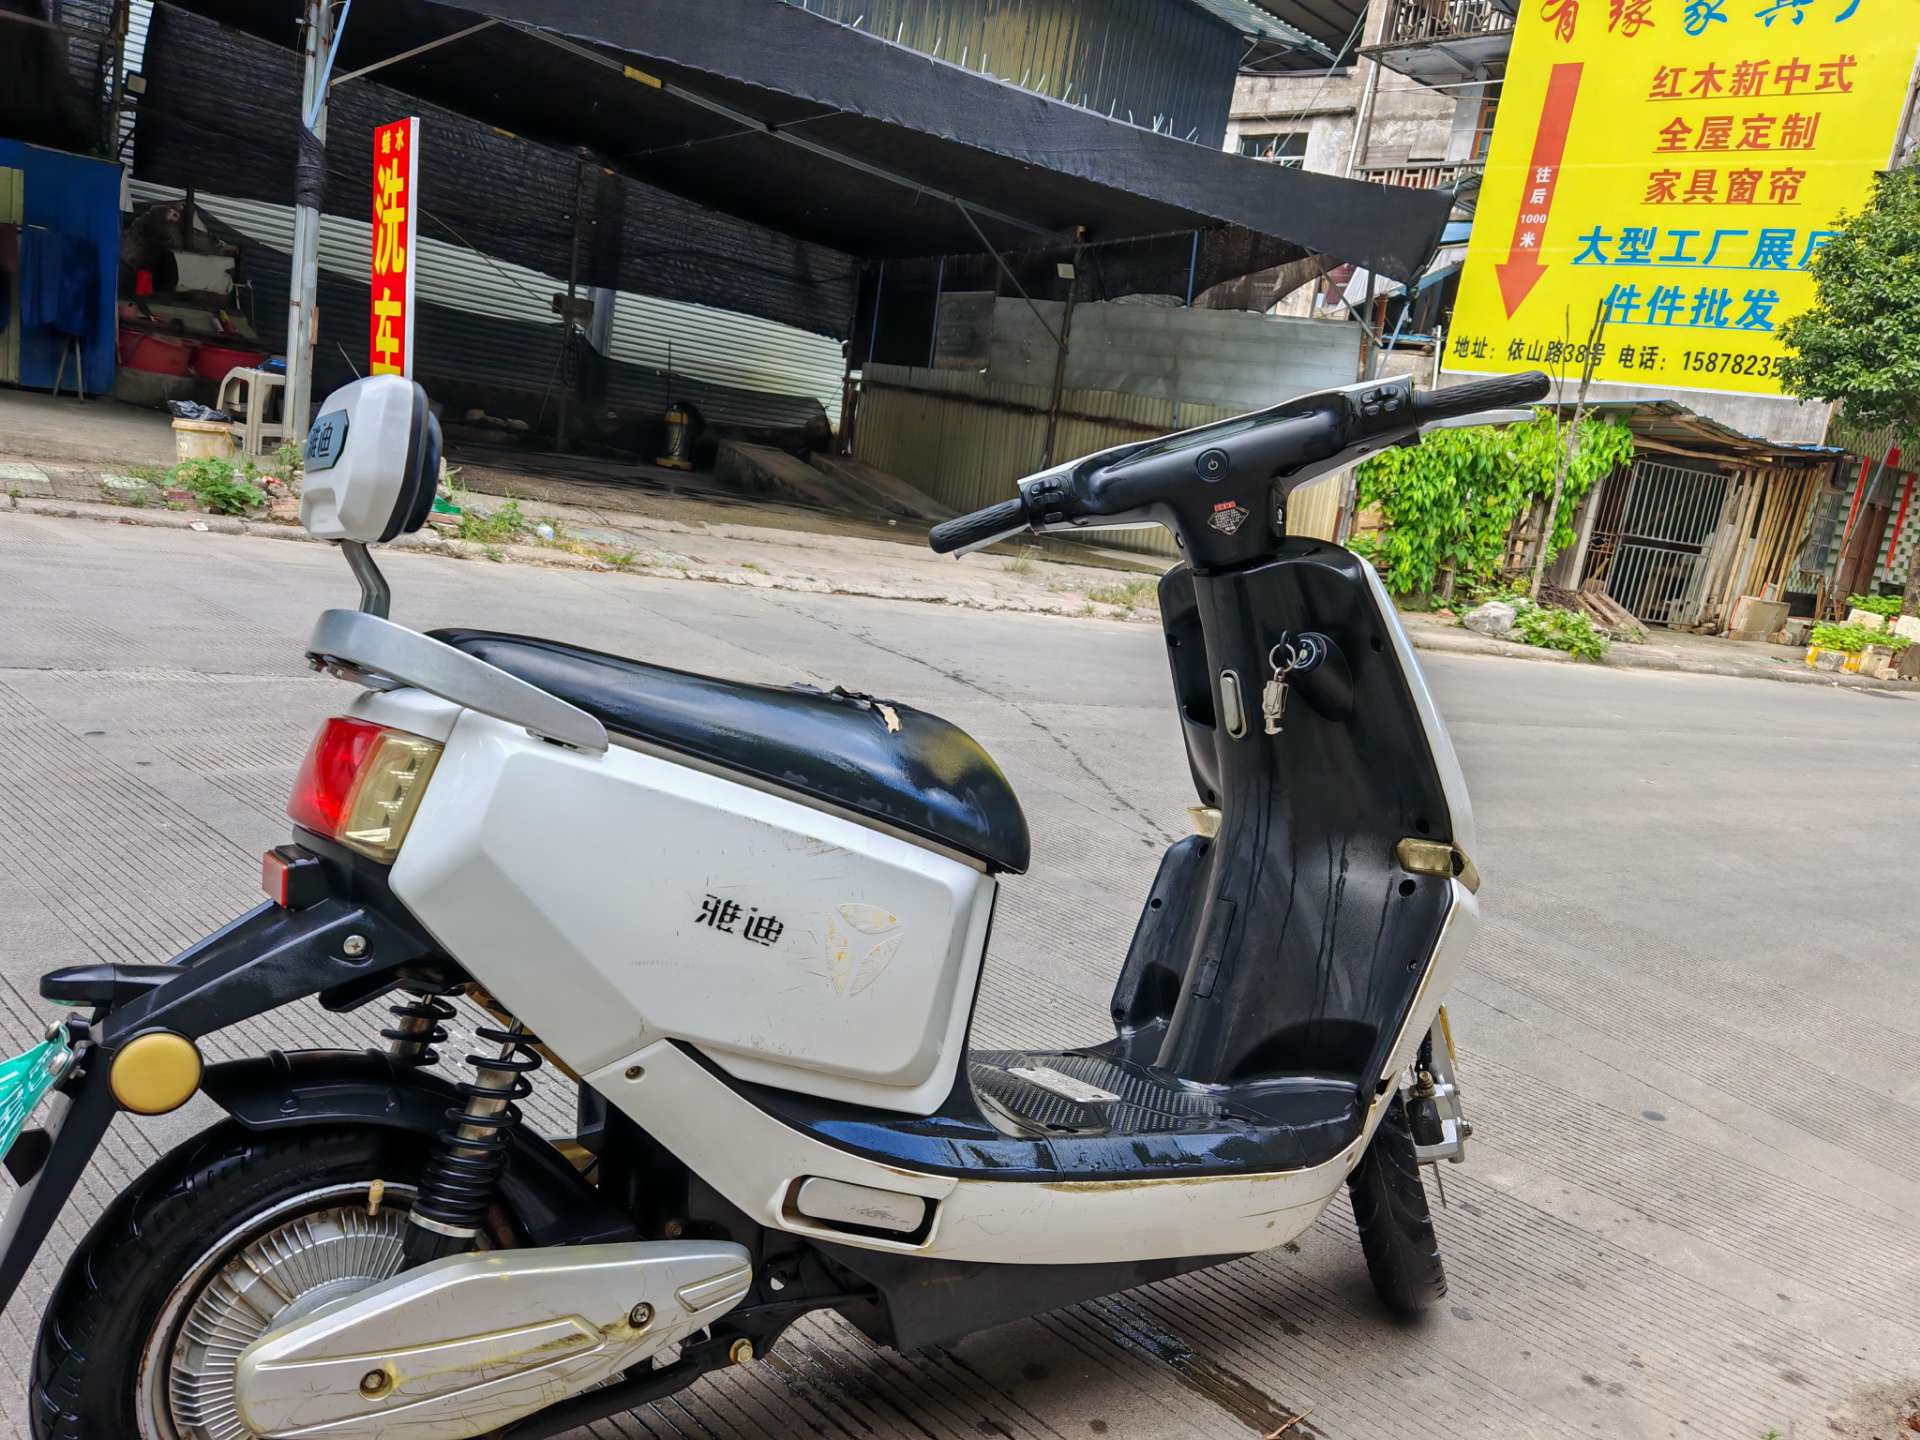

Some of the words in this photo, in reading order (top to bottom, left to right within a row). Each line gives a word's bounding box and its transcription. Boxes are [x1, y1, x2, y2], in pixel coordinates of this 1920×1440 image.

[1648, 54, 1858, 99] 红木新中式
[1656, 112, 1822, 151] 全屋定制
[1519, 166, 1553, 248] 往后1000米
[1643, 167, 1806, 204] 家具窗帘
[374, 158, 405, 376] 洗车
[1600, 283, 1780, 330] 件件批发
[694, 893, 784, 947] 雅迪
